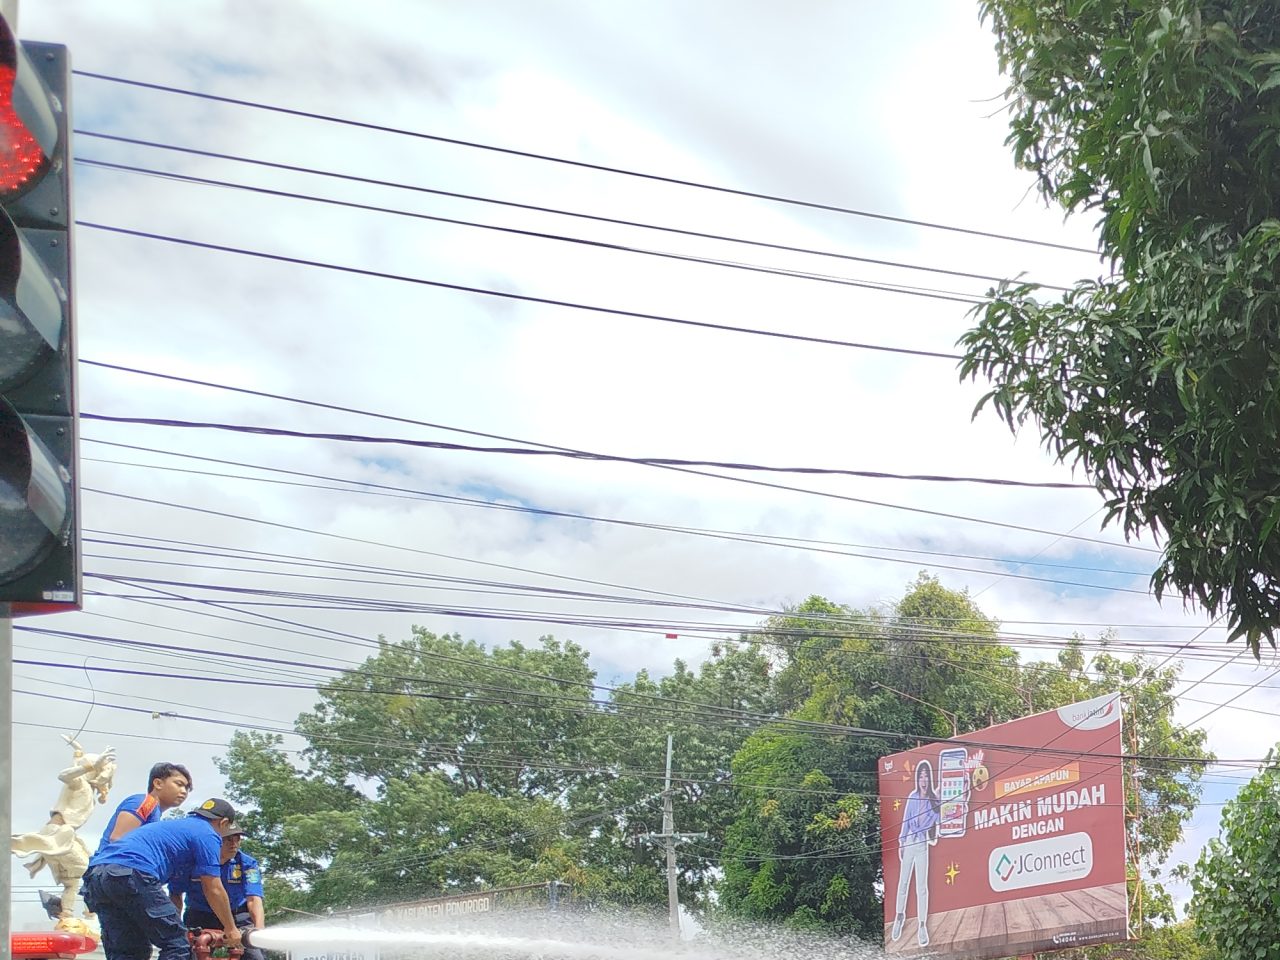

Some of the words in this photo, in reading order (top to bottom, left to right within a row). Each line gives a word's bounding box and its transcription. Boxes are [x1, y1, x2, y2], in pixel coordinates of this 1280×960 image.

[1003, 778, 1032, 793] BAYAR
[1033, 769, 1070, 785] APAPUN
[974, 800, 1032, 830] MAKIN
[1037, 784, 1105, 817] MUDAH
[1012, 817, 1064, 840] DENGAN
[1017, 845, 1086, 874] JConnect
[446, 897, 490, 915] PONOROGO
